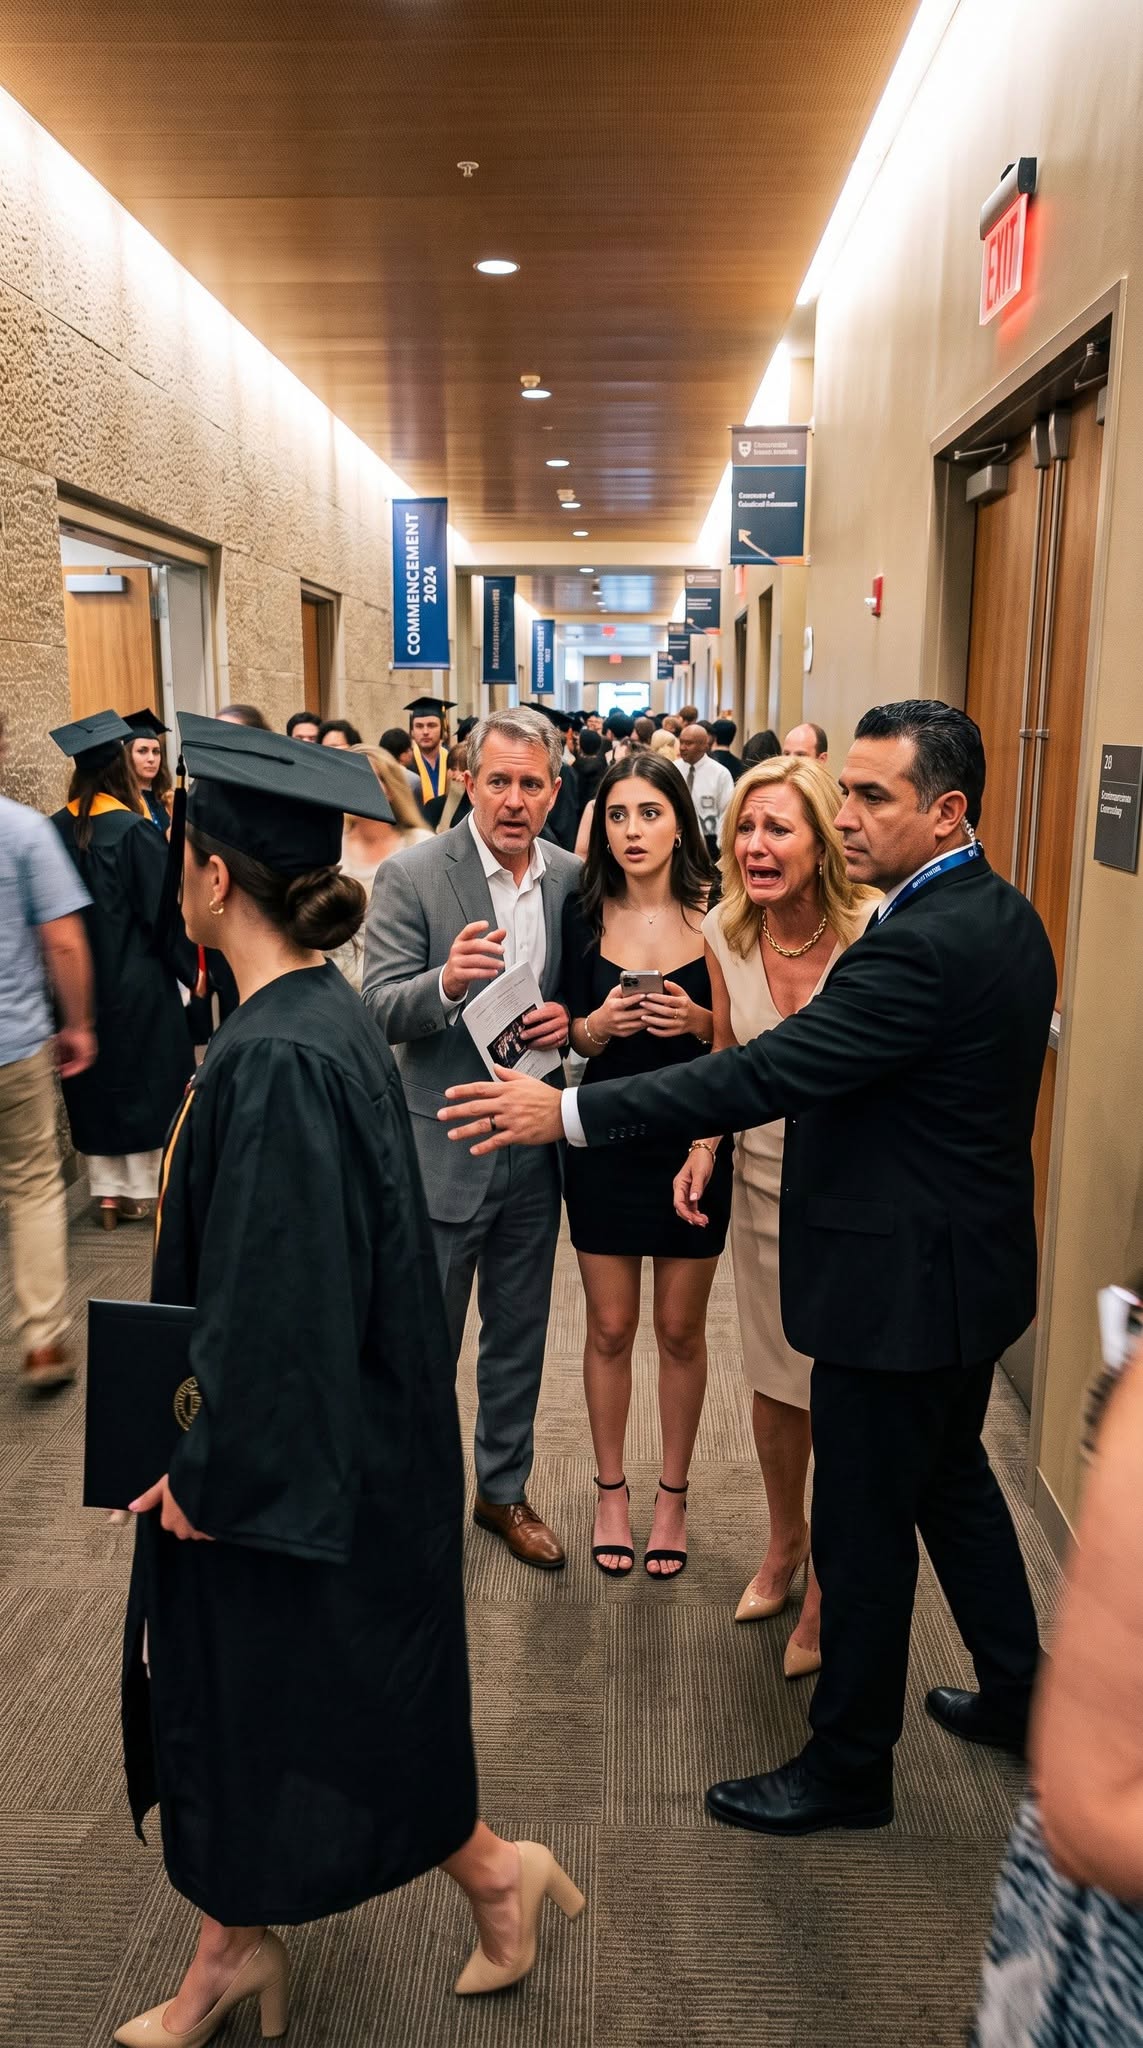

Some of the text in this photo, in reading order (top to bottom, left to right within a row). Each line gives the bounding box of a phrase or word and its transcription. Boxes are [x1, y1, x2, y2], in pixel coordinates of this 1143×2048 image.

[986, 211, 1018, 311] EXIT
[405, 512, 420, 656] COMMENCEMENT
[423, 565, 437, 604] 2024
